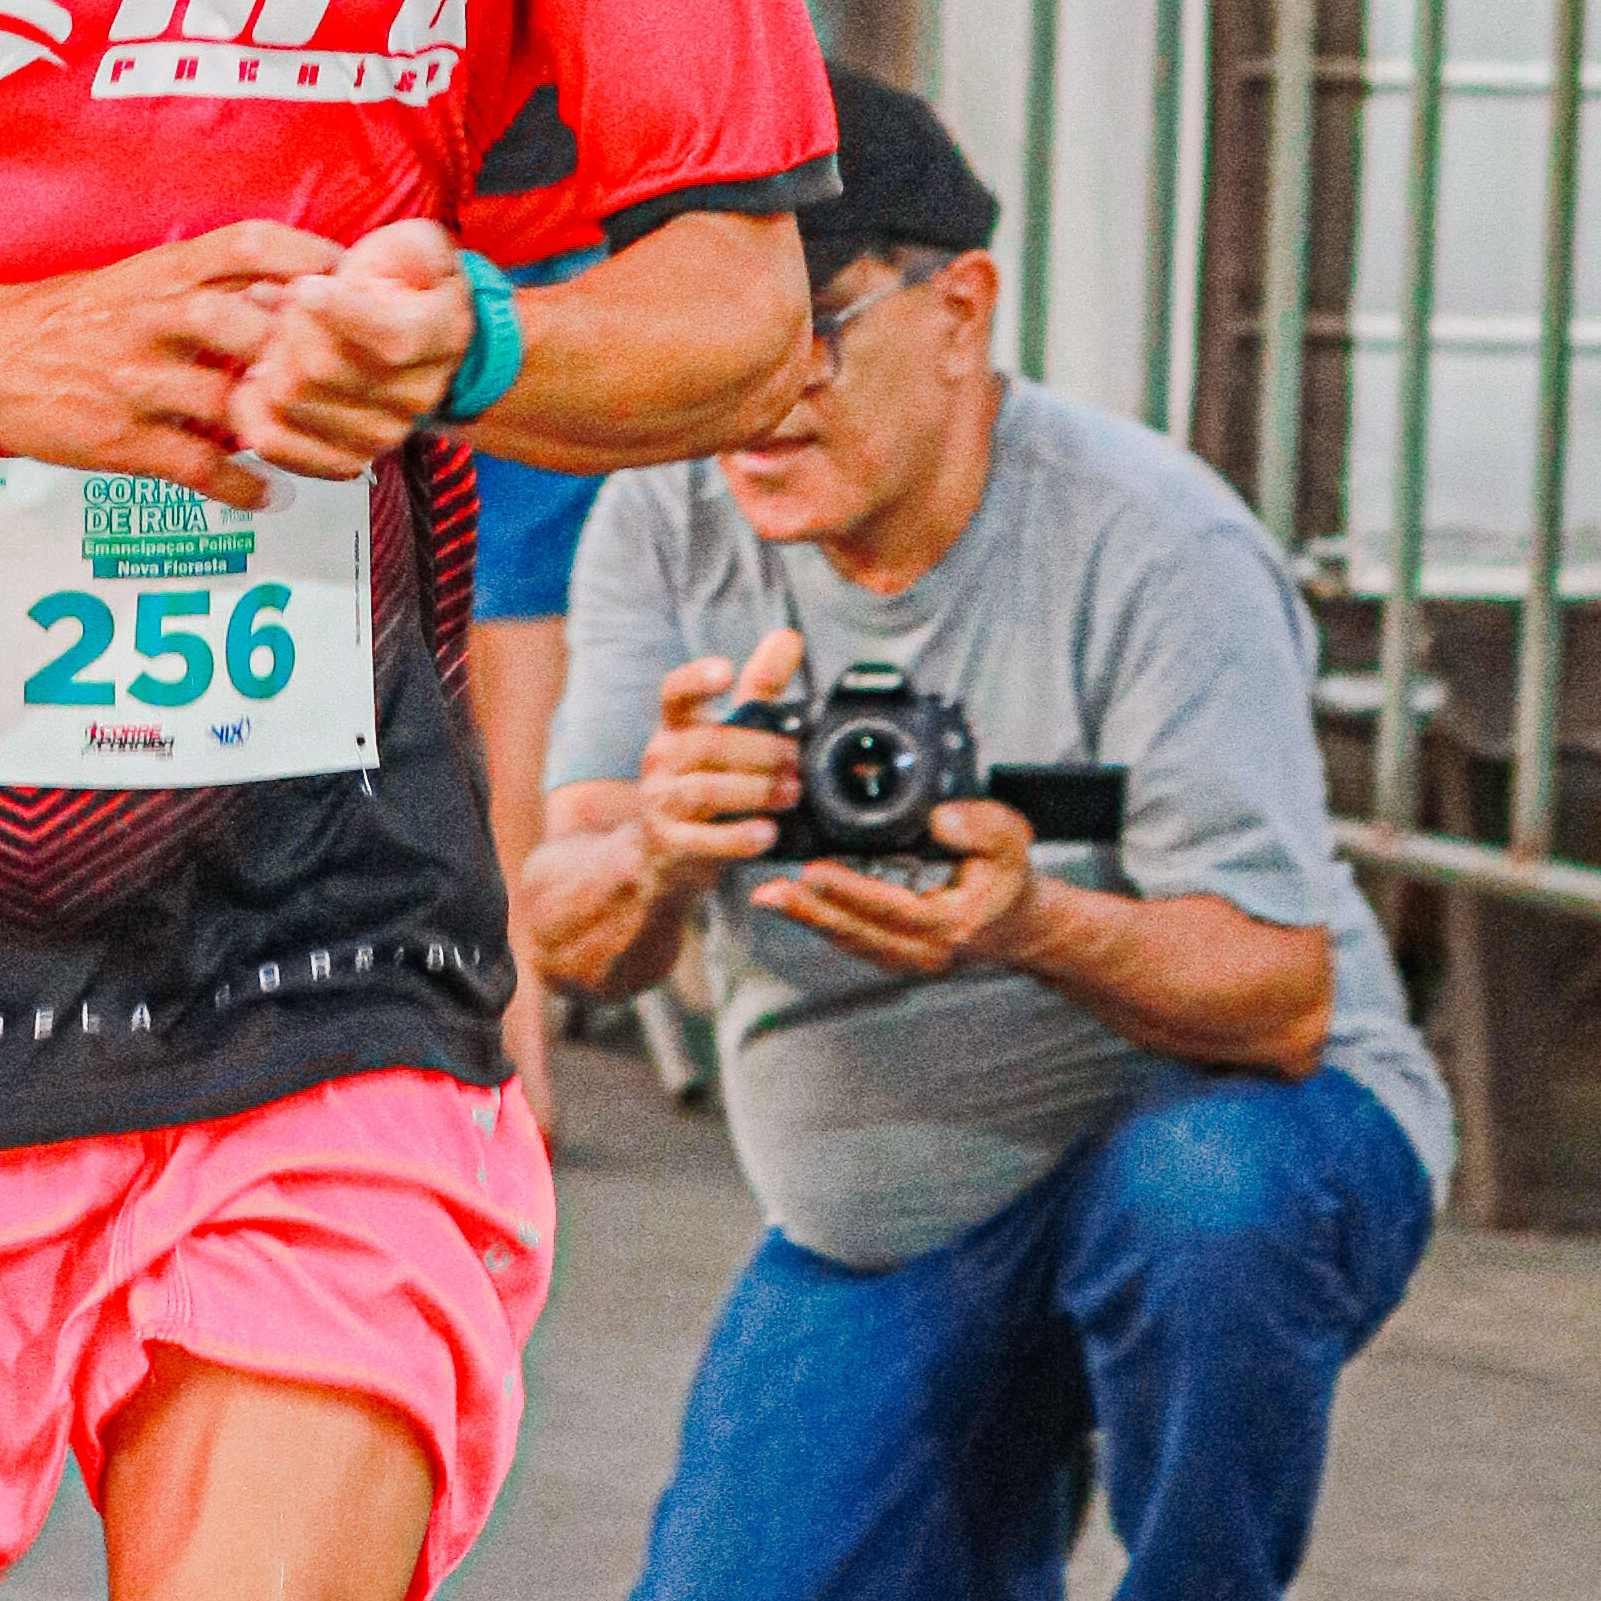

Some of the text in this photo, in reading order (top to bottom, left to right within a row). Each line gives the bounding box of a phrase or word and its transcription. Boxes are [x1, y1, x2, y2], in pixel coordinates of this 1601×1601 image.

[85, 506, 131, 534] DE
[140, 504, 208, 534] RUA
[118, 558, 227, 576] Nova Floresta
[23, 582, 296, 706] 256
